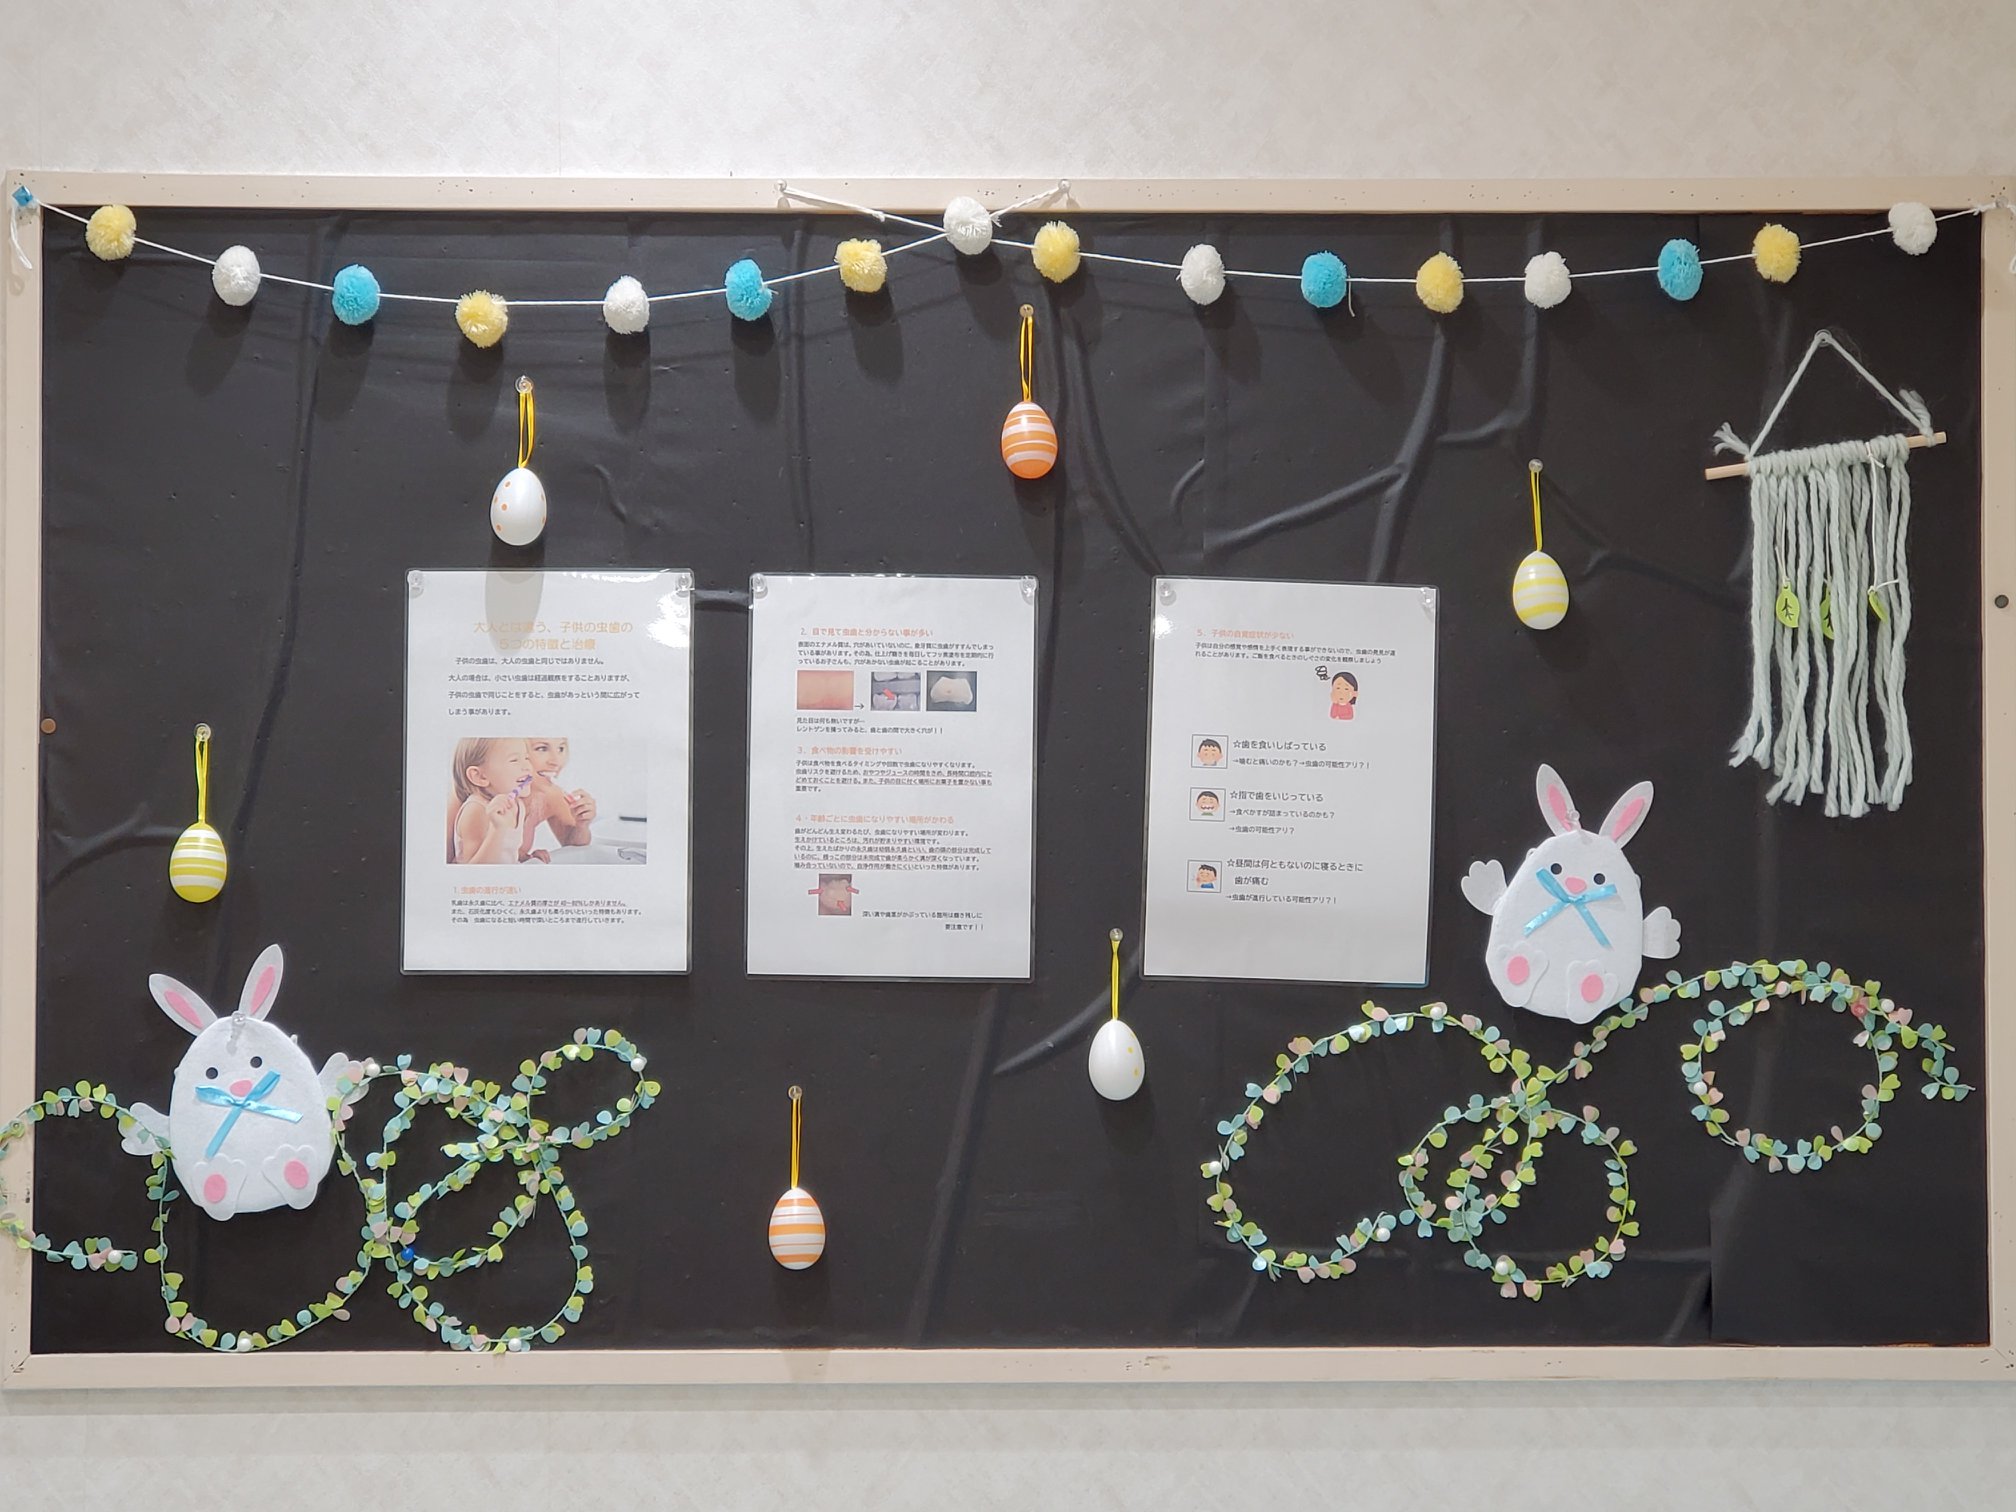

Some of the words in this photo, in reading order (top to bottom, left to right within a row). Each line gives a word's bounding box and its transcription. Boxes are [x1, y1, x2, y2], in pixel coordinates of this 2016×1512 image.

[455, 657, 605, 665] 子供の虫歯は、大人の虫歯と同じではありません。
[448, 708, 512, 716] しまう事があります。
[1235, 876, 1269, 886] 歯が痛む
